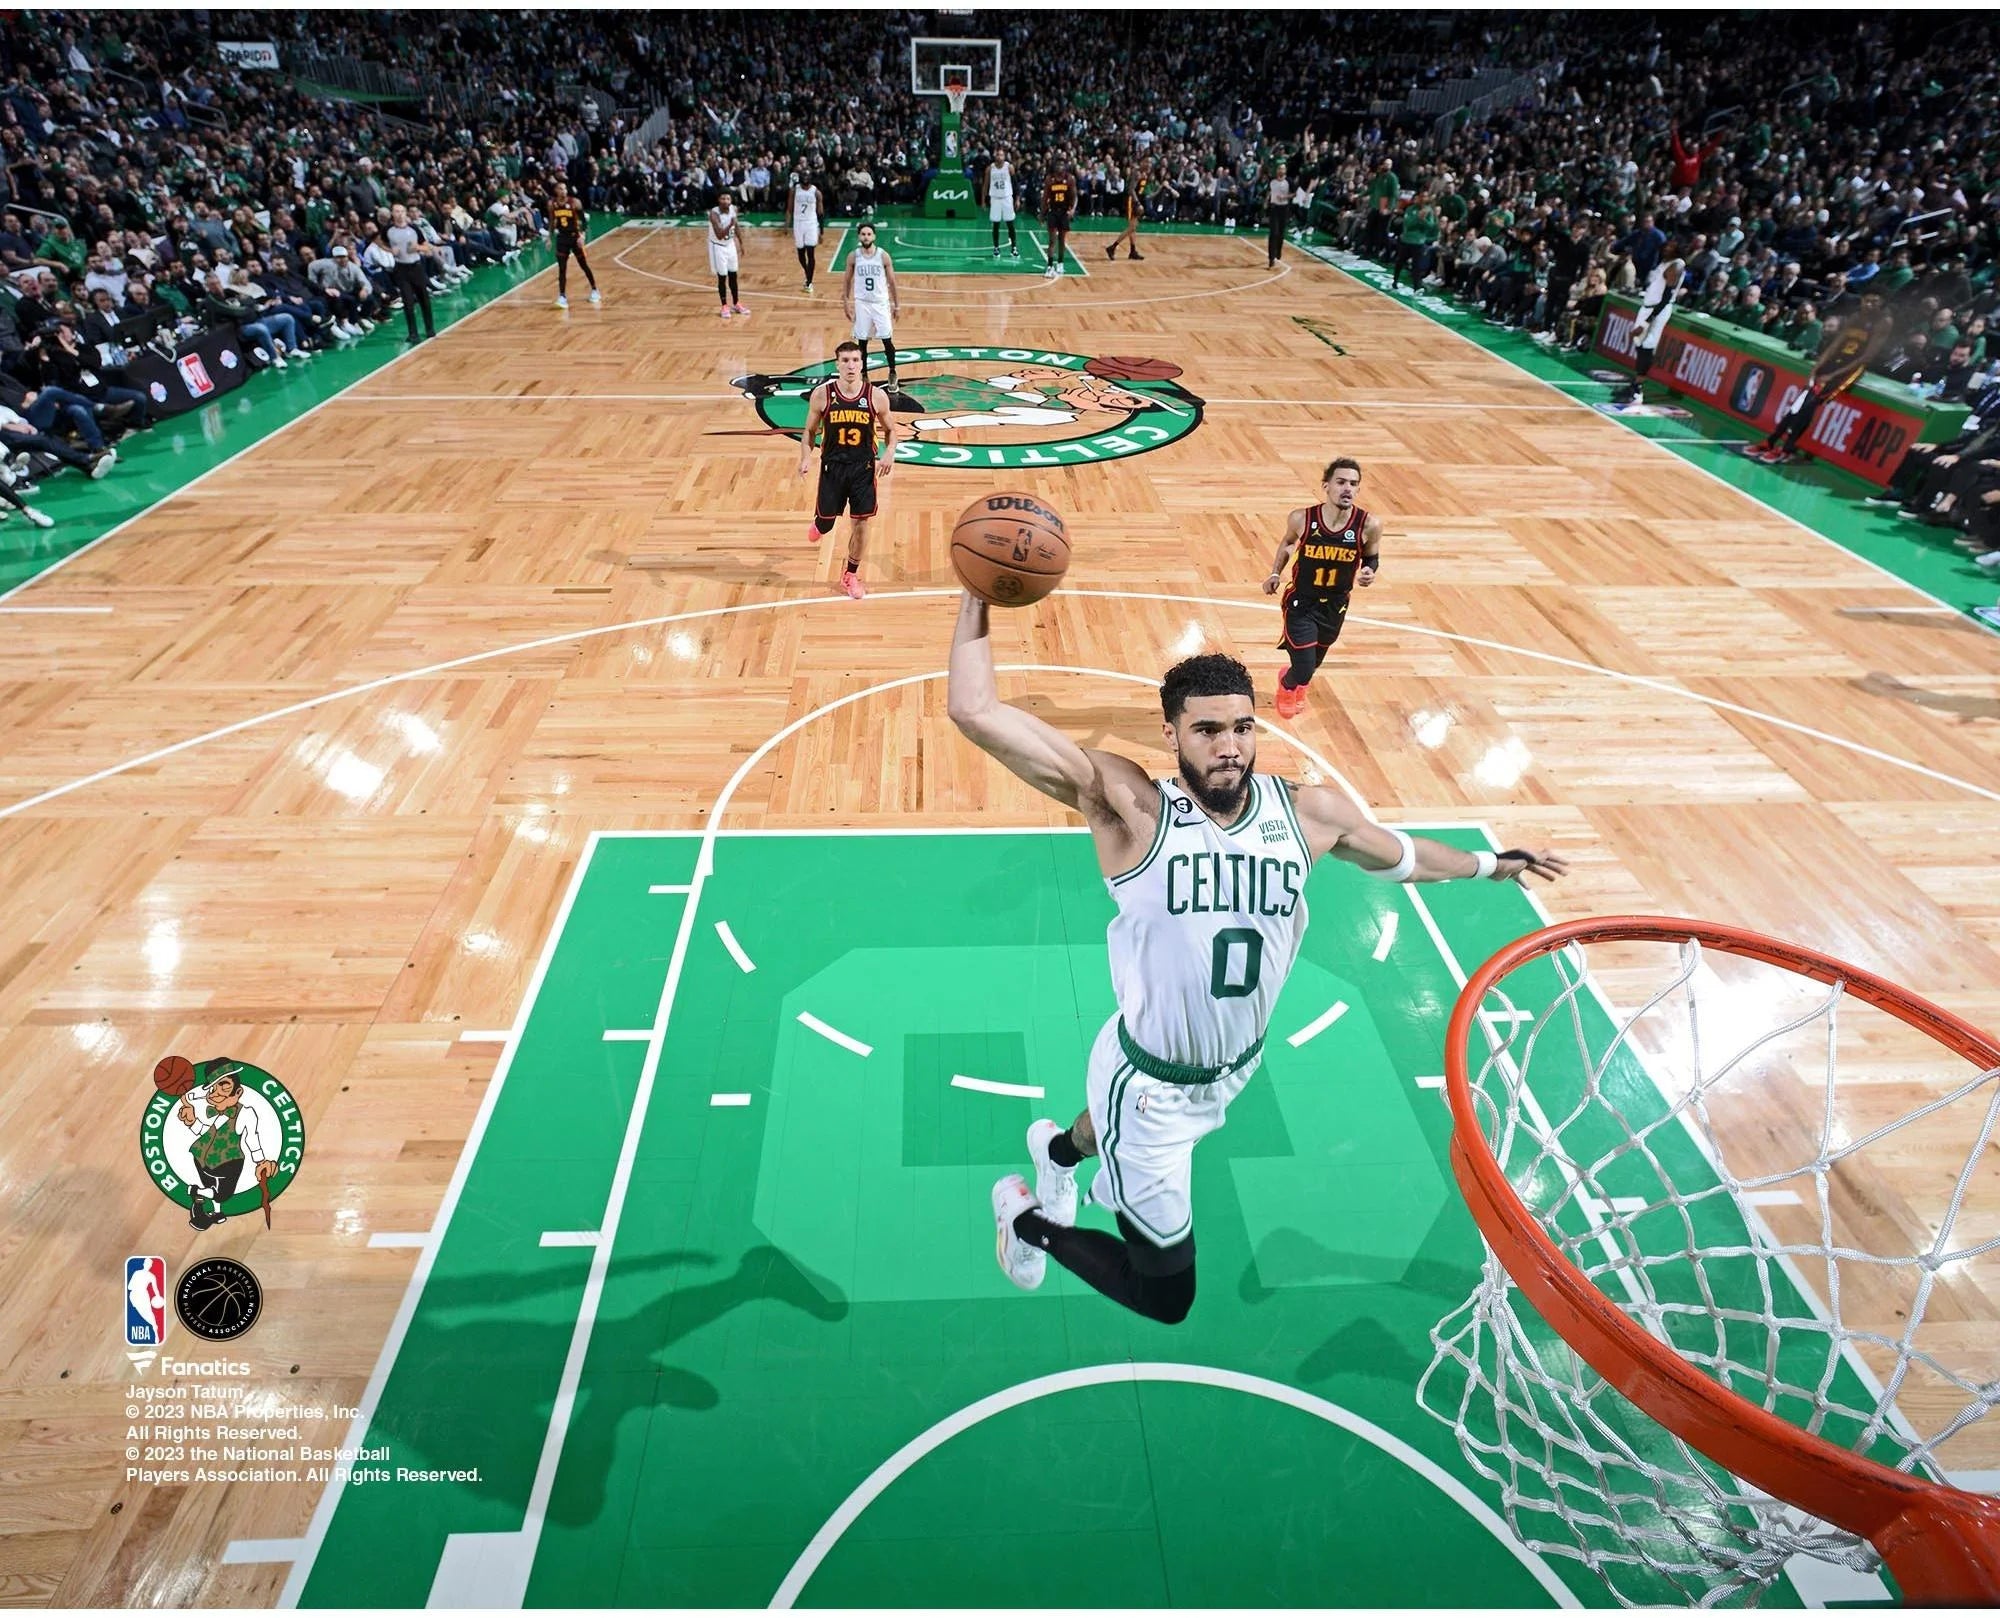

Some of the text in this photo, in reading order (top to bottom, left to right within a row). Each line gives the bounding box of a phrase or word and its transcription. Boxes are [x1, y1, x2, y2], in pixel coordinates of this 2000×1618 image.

[994, 180, 1006, 190] 42
[801, 203, 808, 214] 7
[864, 277, 875, 291] 9
[1602, 312, 1635, 353] THIS
[829, 409, 870, 425] HAWKS
[838, 427, 861, 446] 13
[1812, 400, 1862, 453] THE
[1851, 416, 1907, 469] APP
[893, 425, 1170, 464] CELTICS
[1304, 544, 1357, 563] HAWKS
[1313, 567, 1337, 587] 11
[1258, 819, 1287, 835] VISTA
[1262, 831, 1290, 845] PRINT
[1167, 852, 1301, 918] CELTICS
[1210, 927, 1264, 1000] 0
